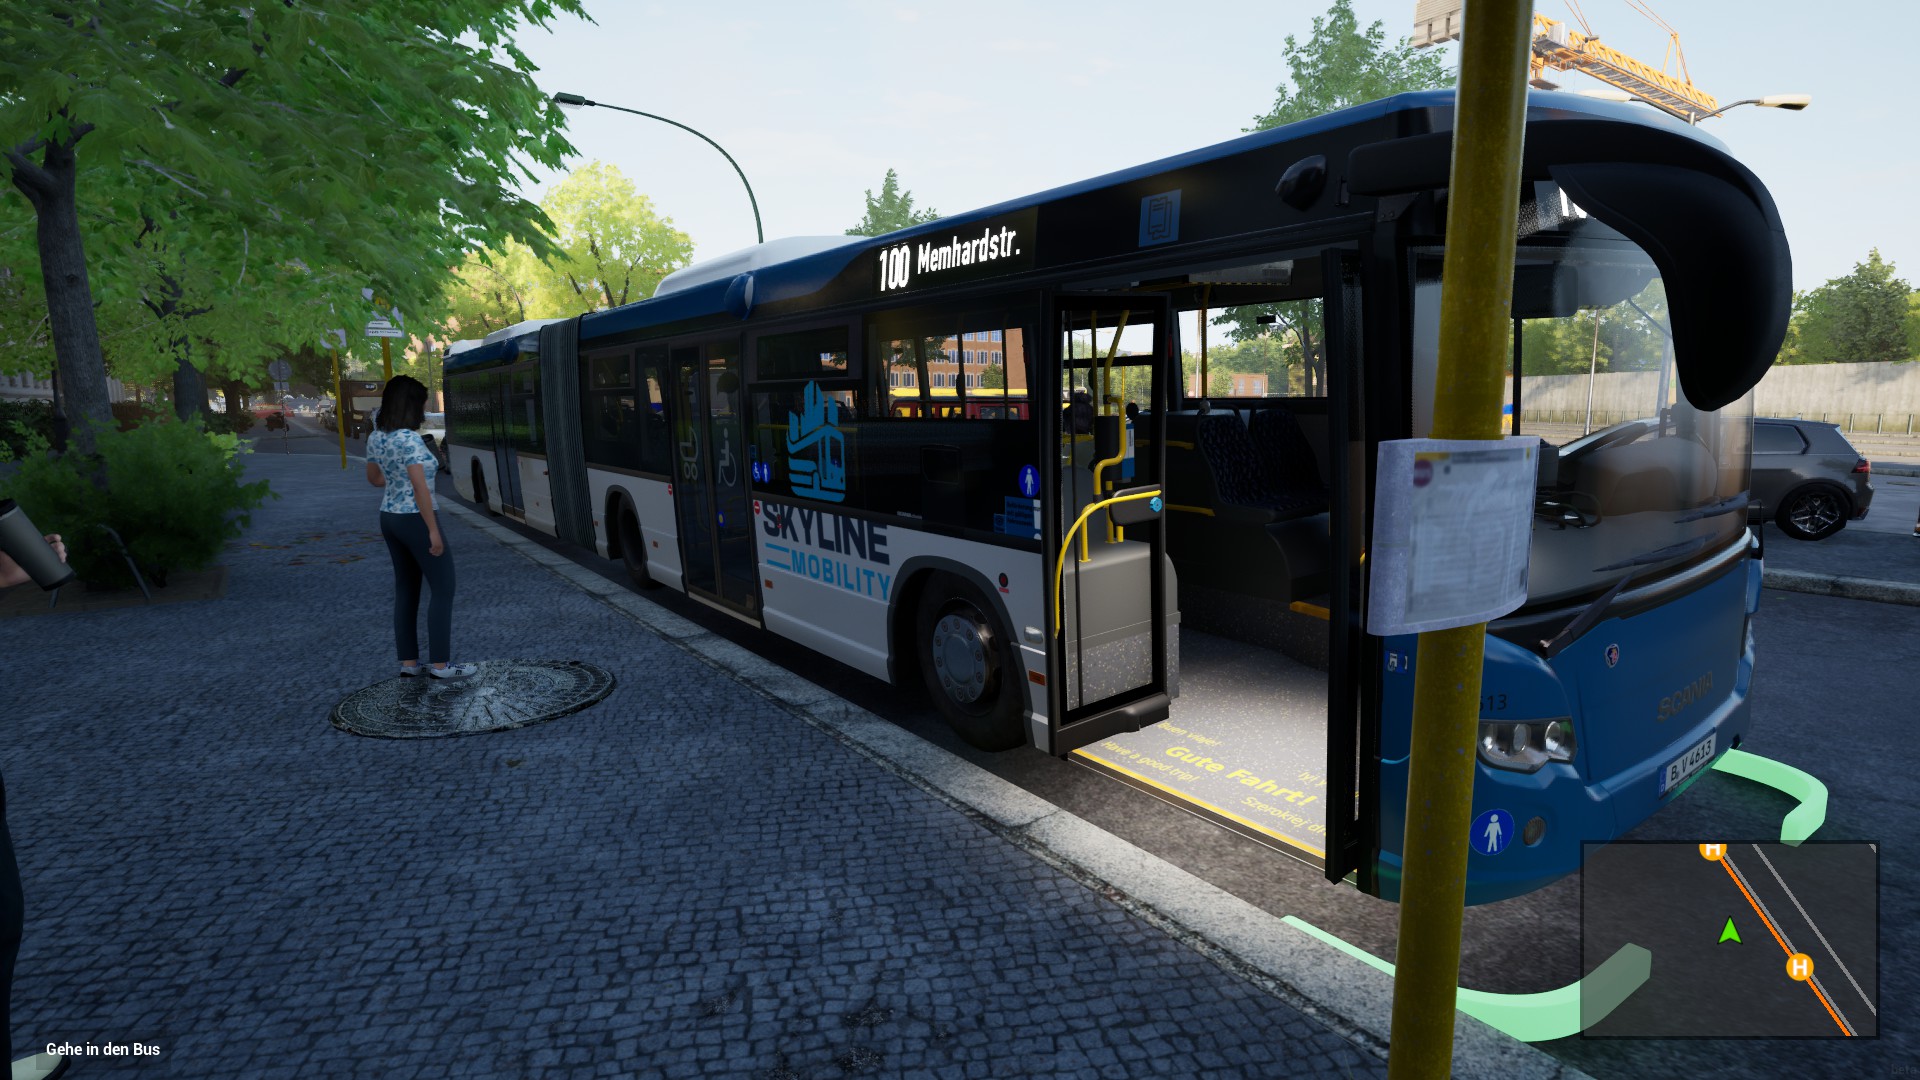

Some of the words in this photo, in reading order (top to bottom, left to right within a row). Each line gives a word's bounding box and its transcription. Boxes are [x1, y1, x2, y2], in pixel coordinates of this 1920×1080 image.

[879, 245, 911, 292] 100
[917, 225, 1021, 274] Memhardstr.
[762, 502, 890, 566] SKYLINE
[791, 549, 891, 601] MOBILITY
[1656, 671, 1713, 723] SCANIA
[1101, 741, 1131, 755] Have
[1129, 751, 1139, 760] a
[1140, 756, 1170, 772] good
[1165, 746, 1225, 773] Gute
[1225, 769, 1318, 807] Fahrt!
[1670, 765, 1678, 781] B
[1681, 756, 1690, 773] V
[1689, 739, 1712, 767] 4613
[1240, 796, 1309, 828] Szerokiej
